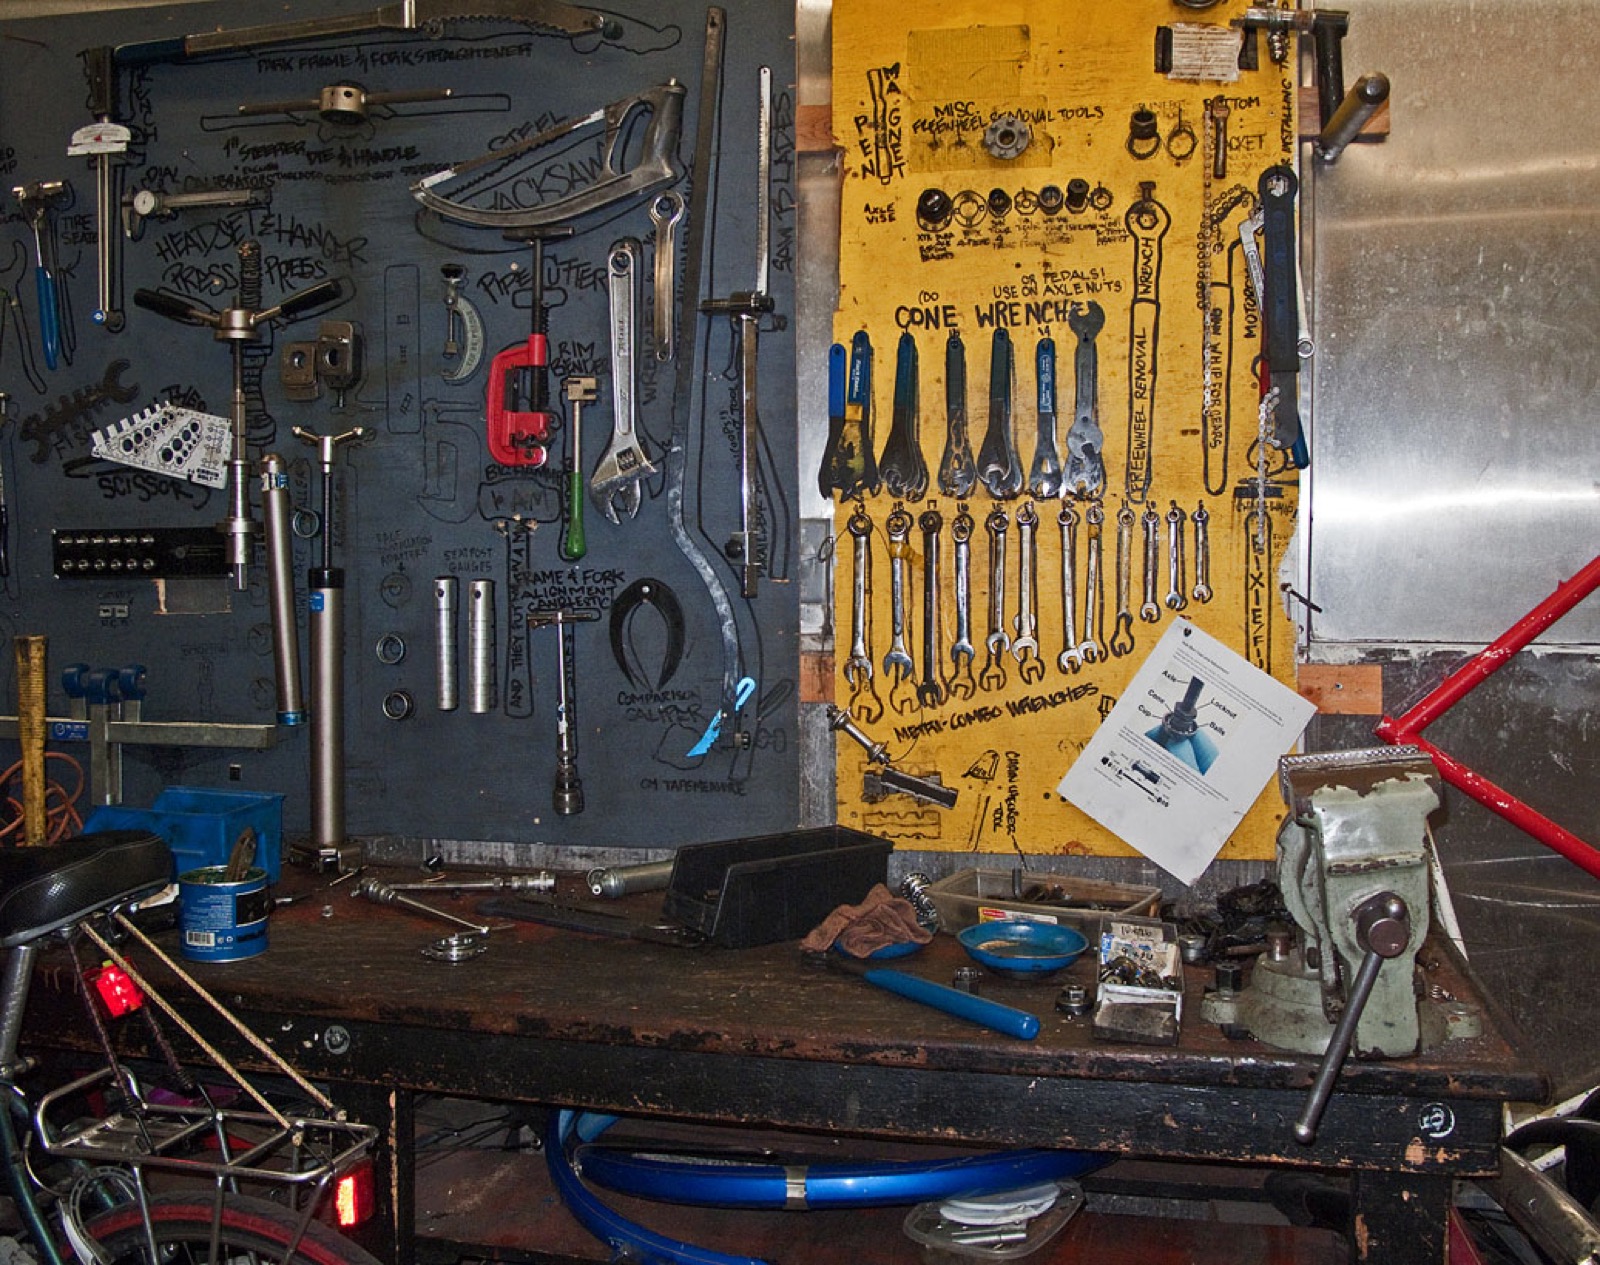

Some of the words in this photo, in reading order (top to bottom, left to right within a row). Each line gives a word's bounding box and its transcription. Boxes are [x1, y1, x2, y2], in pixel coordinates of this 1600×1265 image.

[882, 62, 906, 178] MAGNET
[1058, 106, 1104, 119] TOOLS
[854, 115, 875, 180] PEN
[866, 213, 896, 223] VISE
[771, 226, 793, 273] SAW
[1138, 237, 1156, 295] WRENCH
[477, 265, 531, 303] PIPE
[993, 285, 1018, 299] USE
[1022, 285, 1038, 297] ON
[1042, 283, 1082, 296] AXLE
[895, 304, 959, 330] CONE
[559, 342, 595, 359] RIM
[1135, 327, 1147, 400] REMOVAL
[1130, 405, 1149, 495] FREEWHEEL
[583, 569, 625, 585] FORK
[511, 636, 524, 672] THEY
[1162, 670, 1177, 683] Axle
[509, 679, 523, 708] AND
[1147, 689, 1166, 704] Cone
[1138, 704, 1152, 717] Cup
[1210, 698, 1237, 719] Locknut
